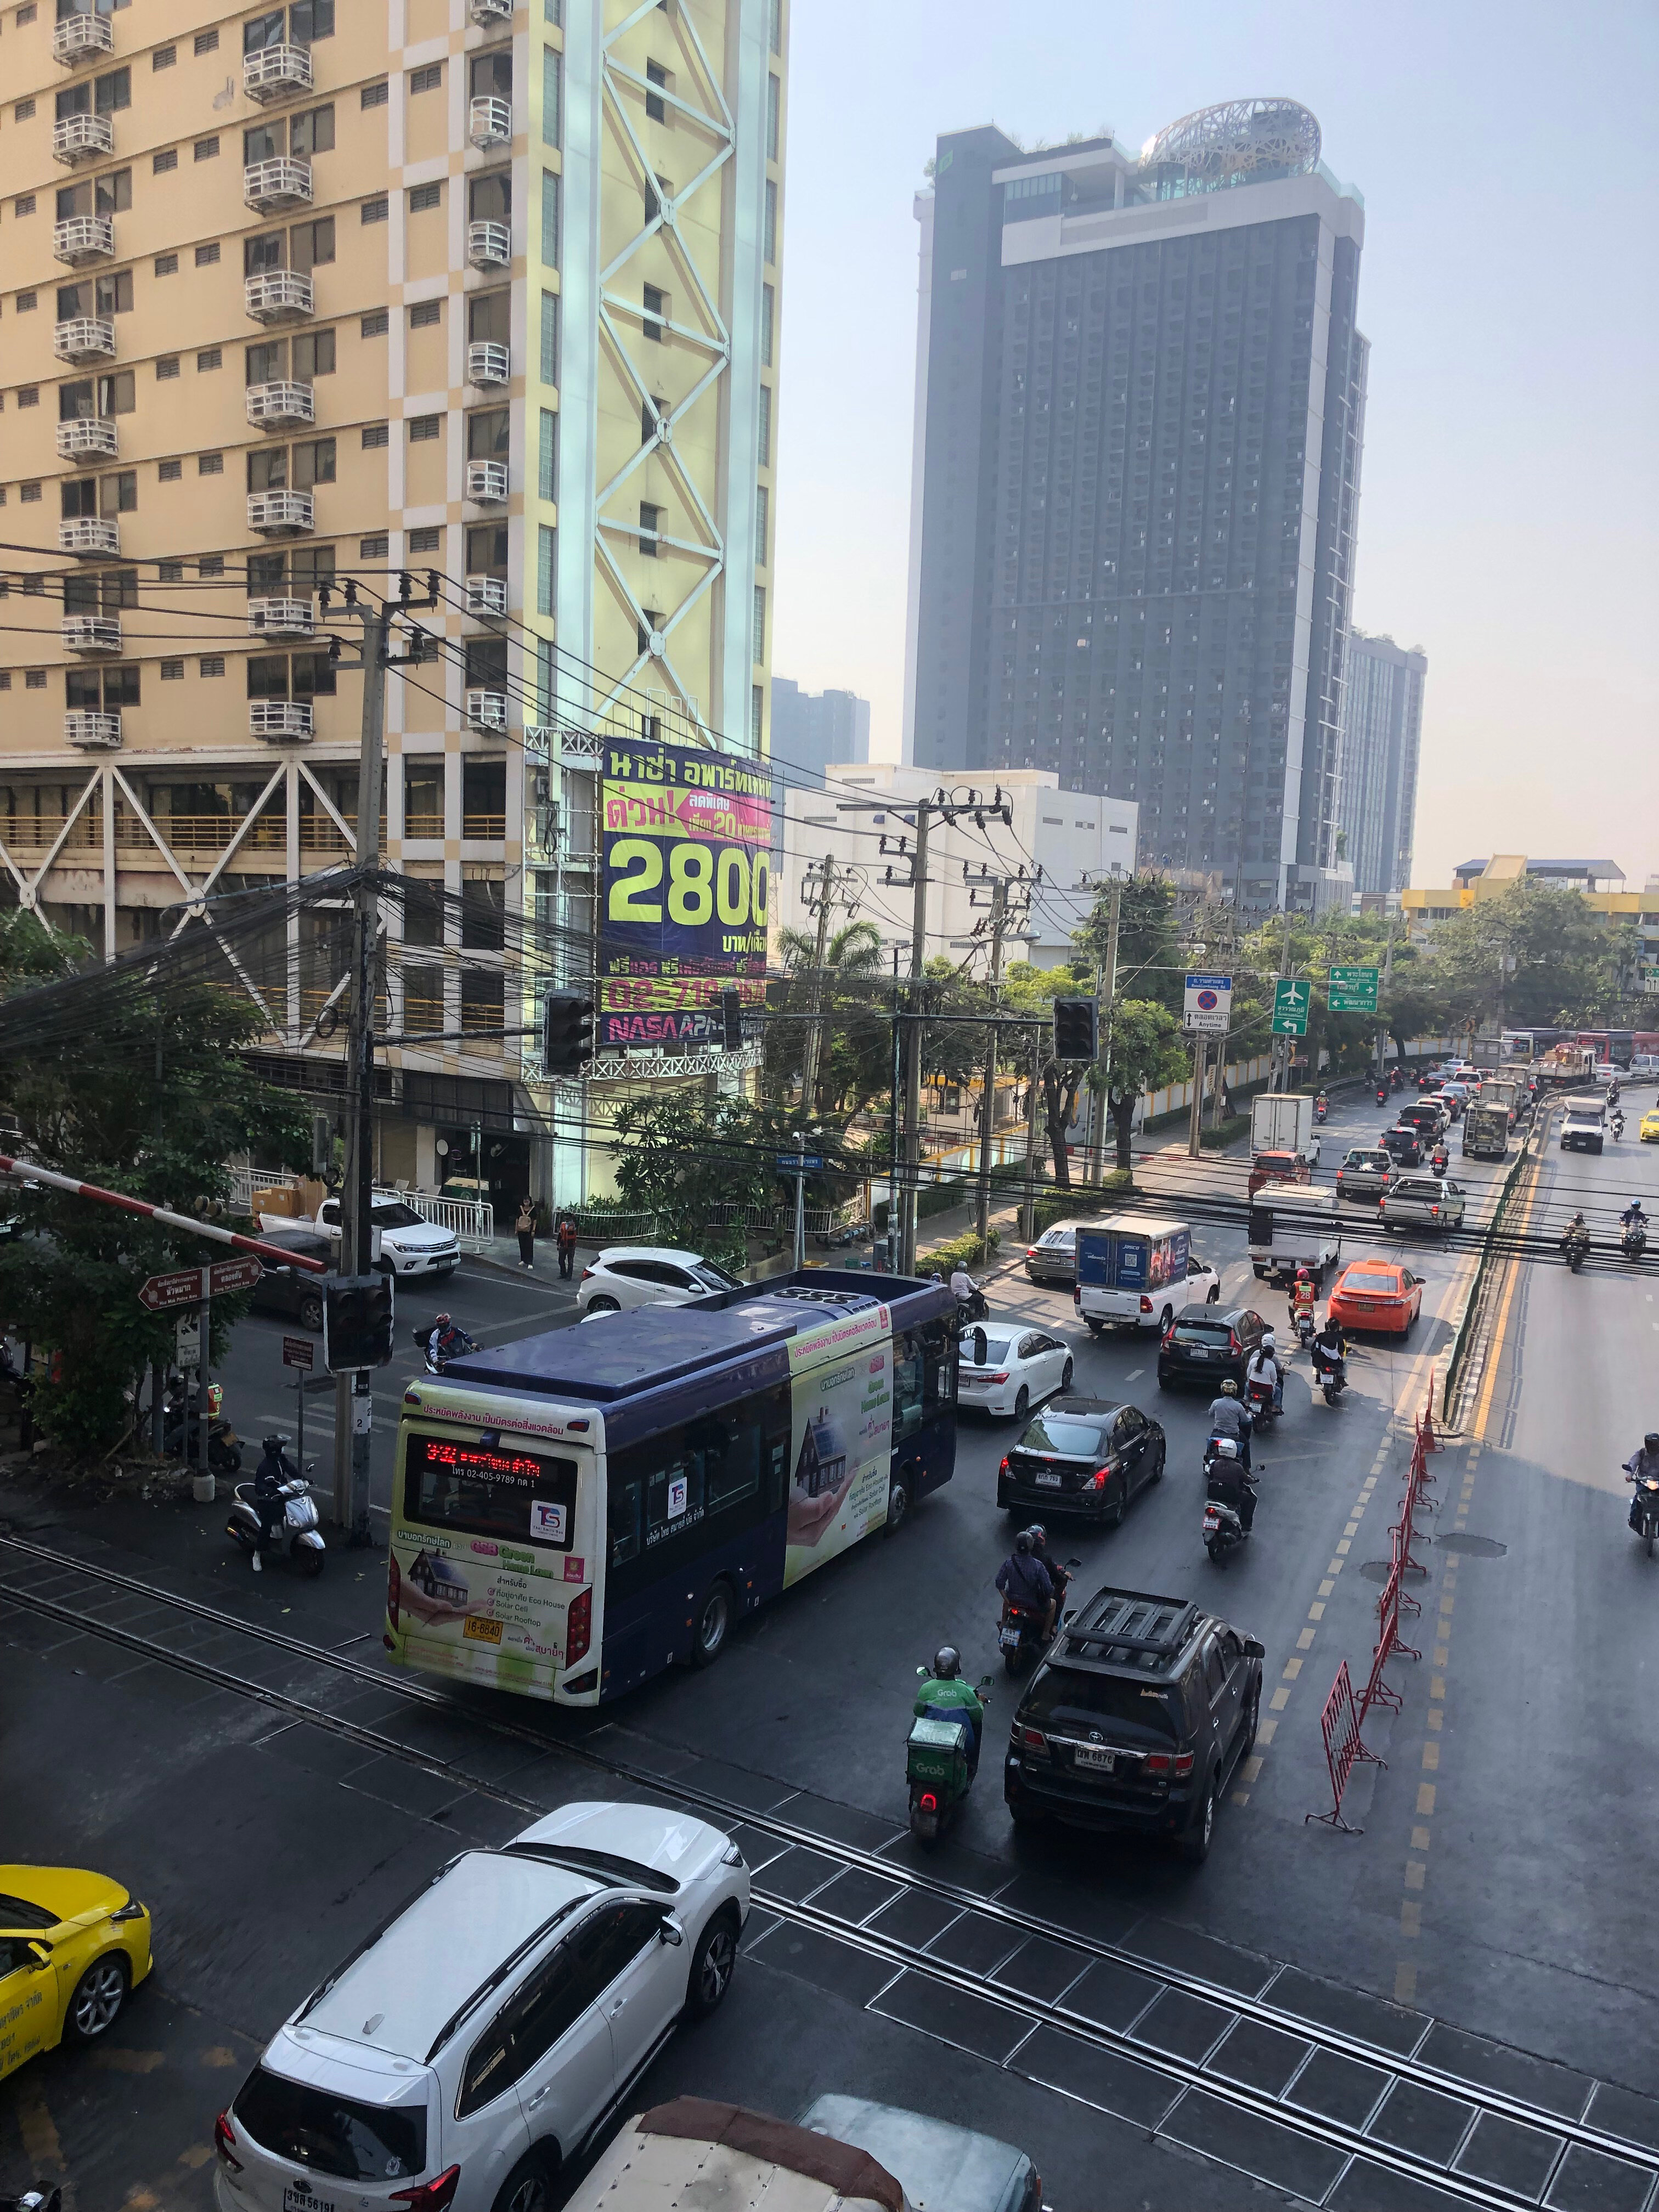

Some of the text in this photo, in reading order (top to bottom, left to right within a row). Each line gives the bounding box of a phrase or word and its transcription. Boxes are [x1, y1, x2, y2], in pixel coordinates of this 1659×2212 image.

[610, 748, 676, 782] นาซ่า
[606, 786, 675, 828] ด่วน!
[690, 793, 730, 811] ลดพิเศษ
[689, 812, 712, 833] เพียง
[714, 811, 736, 839] 20
[609, 839, 770, 927] 2800
[609, 1015, 678, 1041] NASA
[167, 1284, 191, 1296] หัวหมาก
[794, 1338, 832, 1358] ประหยัดพลังงาน
[357, 1419, 363, 1427] 2
[423, 1404, 564, 1436] ประหยัดพลังงาน เป็นมิตรต่อสิ่งแวดล้อม
[452, 1464, 535, 1488] โทร 02-405-9789 กด 1
[646, 1529, 660, 1545] บริษัท
[661, 1526, 669, 1538] ไทย
[398, 1531, 450, 1548] มาบอกรักษ์โลก
[499, 1545, 535, 1564] Green
[503, 1560, 554, 1579] Home Loan
[497, 1577, 527, 1589] สำหรับซื้อ
[496, 1588, 566, 1610] ที่อยู่อาศัย Eco House
[496, 1600, 528, 1613] Solar Cell
[495, 1611, 513, 1622] Solar
[515, 1614, 541, 1628] Rooftop
[937, 1689, 957, 1697] Grab
[916, 1762, 945, 1776] Grab
